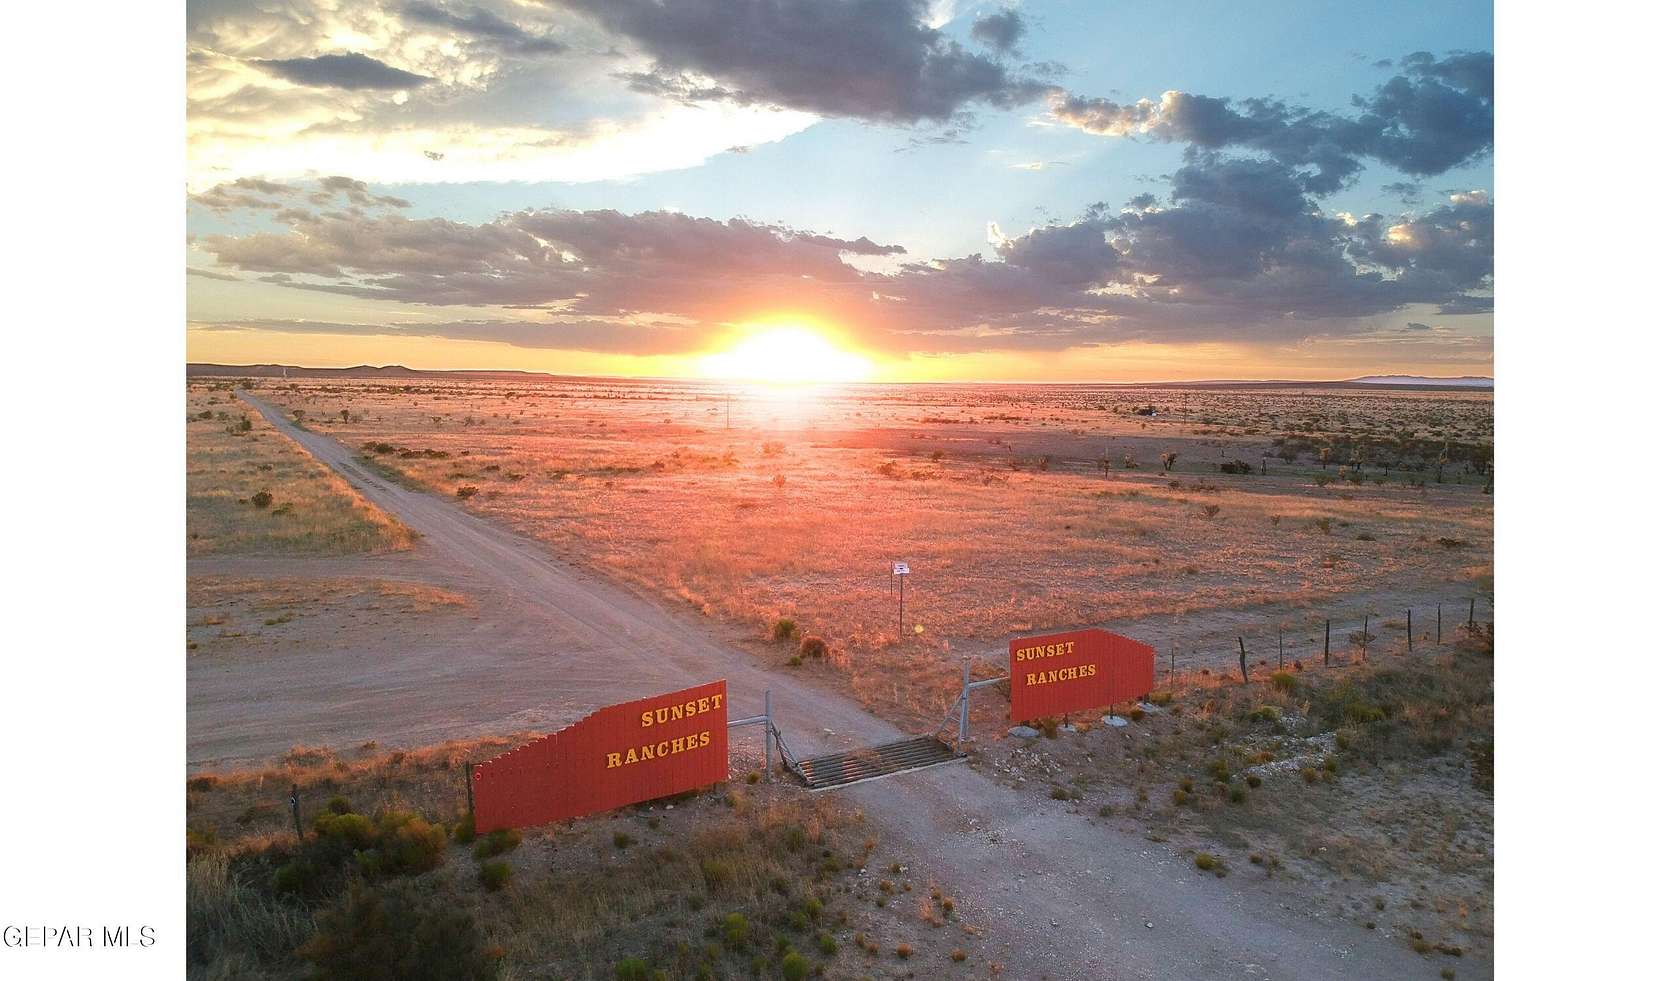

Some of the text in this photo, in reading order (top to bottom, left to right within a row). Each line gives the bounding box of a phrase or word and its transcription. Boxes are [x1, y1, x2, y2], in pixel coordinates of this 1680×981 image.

[1016, 642, 1074, 661] SUNSET
[1026, 664, 1096, 686] RANCHES
[641, 694, 723, 727] SUNSET
[607, 731, 710, 769] RANCHES
